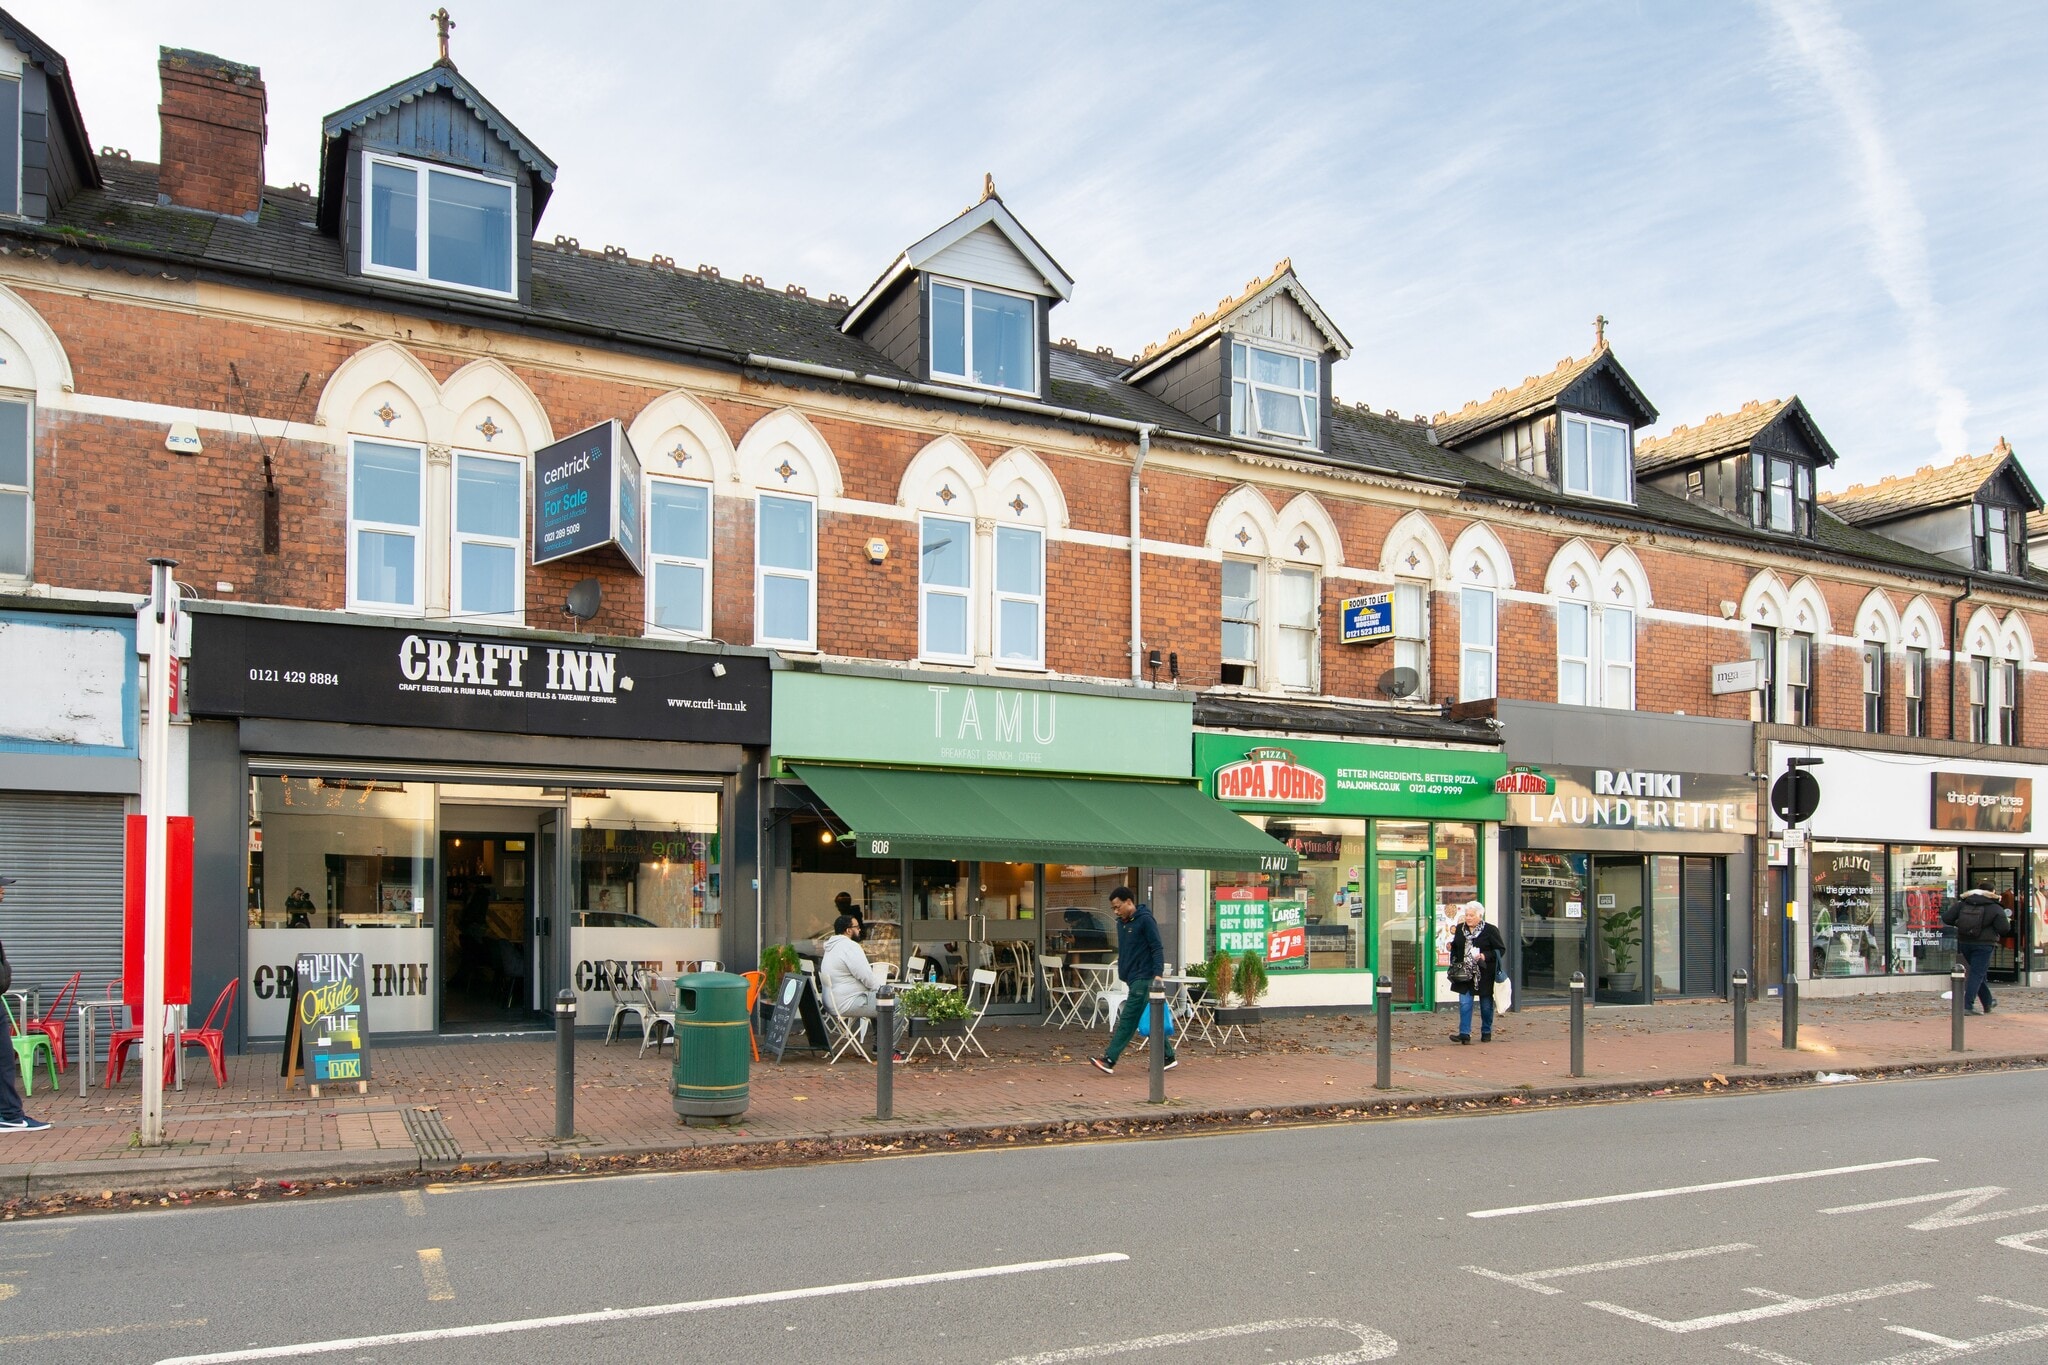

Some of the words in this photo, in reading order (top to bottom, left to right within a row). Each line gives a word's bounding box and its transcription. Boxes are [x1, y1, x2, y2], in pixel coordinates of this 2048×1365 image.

[544, 451, 590, 484] centrick
[545, 500, 561, 518] For
[563, 489, 588, 511] Sale
[1349, 598, 1367, 608] ROOMS
[1377, 595, 1387, 603] LET
[1346, 630, 1359, 638] 0121
[1361, 628, 1372, 636] 523
[398, 635, 528, 687] CRAFT
[546, 648, 616, 693] INN
[250, 669, 279, 682] 0121
[283, 671, 306, 683] 429
[309, 672, 339, 685] 8884
[1717, 671, 1738, 683] mga
[399, 684, 420, 692] CRAFT
[422, 685, 452, 694] BEER,GIN
[460, 687, 476, 695] RUM
[477, 688, 492, 697] BAR,
[493, 689, 524, 698] GROWLER
[525, 691, 550, 700] REFILLS
[558, 693, 590, 702] TAKEAWAY
[591, 695, 617, 704] SERVICE
[667, 698, 747, 712] www.craft-inn.uk
[928, 685, 1056, 745] TAMU
[940, 747, 980, 760] BREAKFAST
[987, 750, 1013, 761] BRUNCH
[1018, 751, 1042, 763] COFFEE
[1260, 750, 1287, 760] PIZZA
[1221, 765, 1266, 797] PAPA
[1337, 768, 1368, 779] BETTER
[1369, 770, 1424, 782] INGREDIENTS.
[1425, 775, 1454, 784] BETTER
[1455, 776, 1478, 785] PIZZA.
[1497, 775, 1516, 792] PAPA
[1595, 770, 1681, 798] RAFIKI
[1337, 781, 1400, 792] PAPAJOHNS.CO.UK
[1409, 785, 1426, 793] 0121
[1427, 786, 1442, 794] 429
[1443, 786, 1463, 795] 9999
[1947, 791, 1966, 804] the
[1967, 792, 2000, 807] ginger
[2000, 795, 2024, 806] tree
[1530, 795, 1735, 829] LAUNDERETTE
[2000, 806, 2022, 814] boutique
[872, 840, 889, 854] 606
[1260, 856, 1288, 871] TAMU
[1814, 871, 1826, 882] SALE
[1826, 885, 1837, 894] the
[1838, 885, 1858, 896] ginger
[1859, 886, 1873, 894] tree
[1907, 893, 1943, 907] OUTLET
[1220, 904, 1241, 915] BUY
[1243, 904, 1264, 915] ONE
[1272, 907, 1300, 922] LARGE
[1910, 909, 1940, 922] STORE
[1220, 918, 1241, 929] GET
[1243, 918, 1264, 929] ONE
[1220, 932, 1264, 950] FREE
[1907, 930, 1918, 938] Real
[298, 953, 361, 983] #DRINK
[372, 963, 428, 997] INN
[301, 977, 359, 1025] Outside
[320, 1014, 356, 1032] THE
[330, 1060, 359, 1078] BOX
